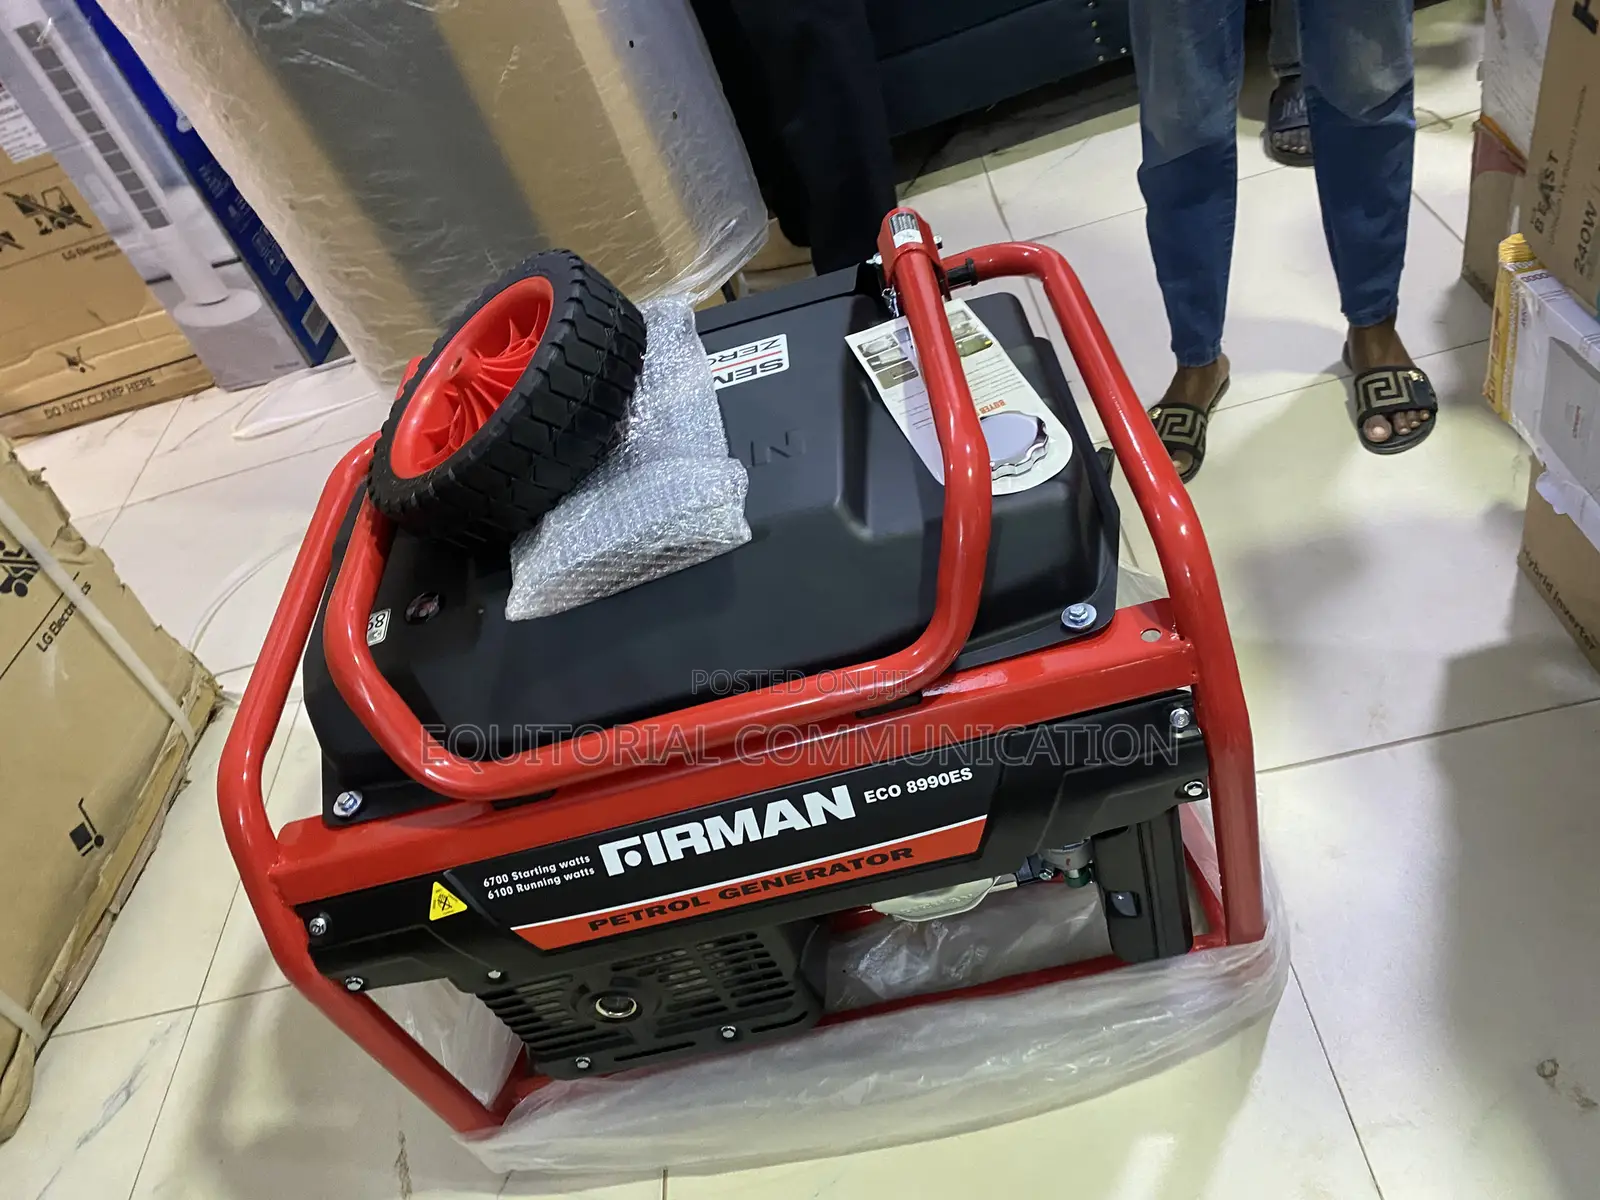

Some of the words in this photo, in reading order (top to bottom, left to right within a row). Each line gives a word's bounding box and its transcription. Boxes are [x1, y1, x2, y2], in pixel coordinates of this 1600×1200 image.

[36, 631, 54, 653] LG
[48, 581, 92, 637] Electrcs
[863, 784, 903, 805] ECO
[905, 767, 974, 795] 8990ES
[598, 784, 857, 877] FIRMAN
[483, 874, 509, 889] 6700
[511, 864, 557, 882] Starting
[558, 854, 591, 871] watts
[487, 885, 513, 900] 6100
[515, 876, 561, 894] Running
[563, 866, 595, 882] watts
[587, 896, 711, 932] PETROL
[718, 847, 914, 901] GENERATOR
